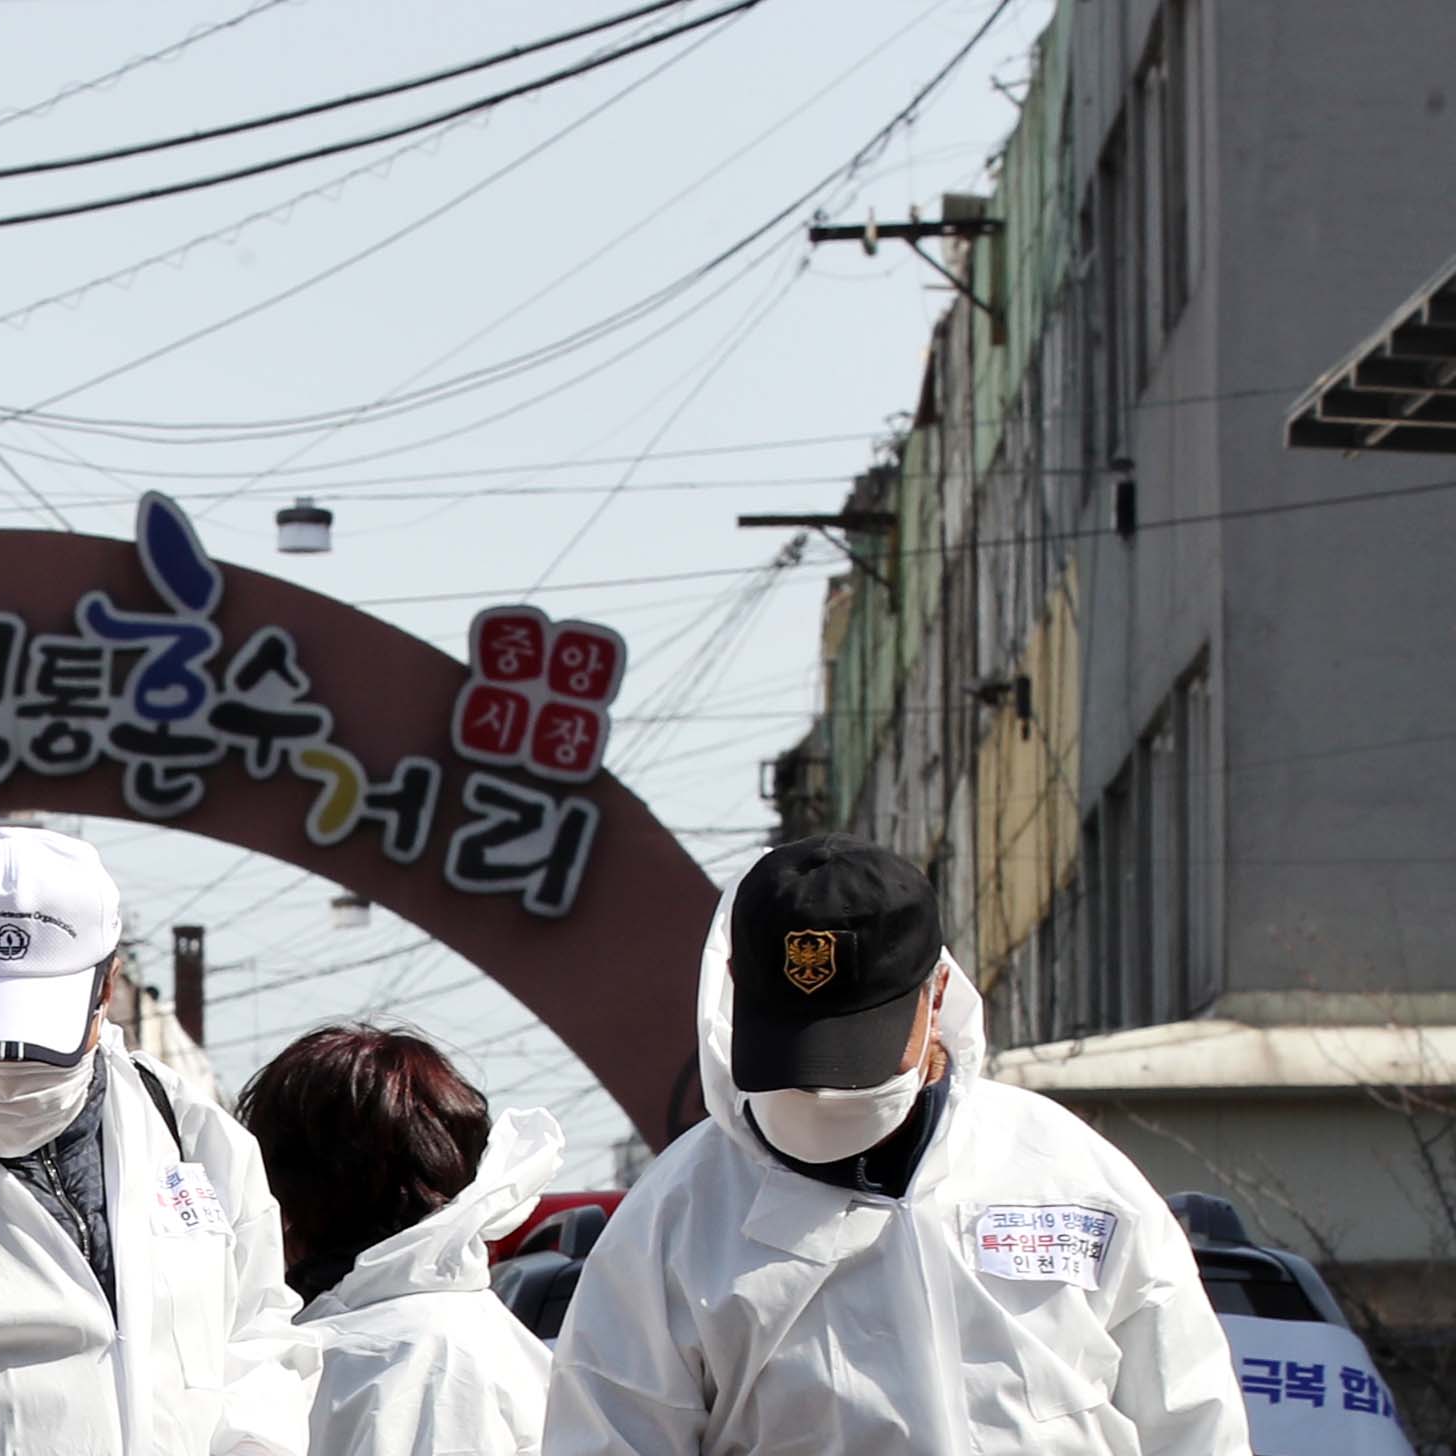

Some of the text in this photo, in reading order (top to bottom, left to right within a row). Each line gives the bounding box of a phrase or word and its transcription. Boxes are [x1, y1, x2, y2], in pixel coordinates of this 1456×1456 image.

[492, 620, 605, 692] 중앙
[473, 698, 591, 765] 시장
[993, 1212, 1056, 1230] 코로나19
[1240, 1357, 1326, 1409] 극복
